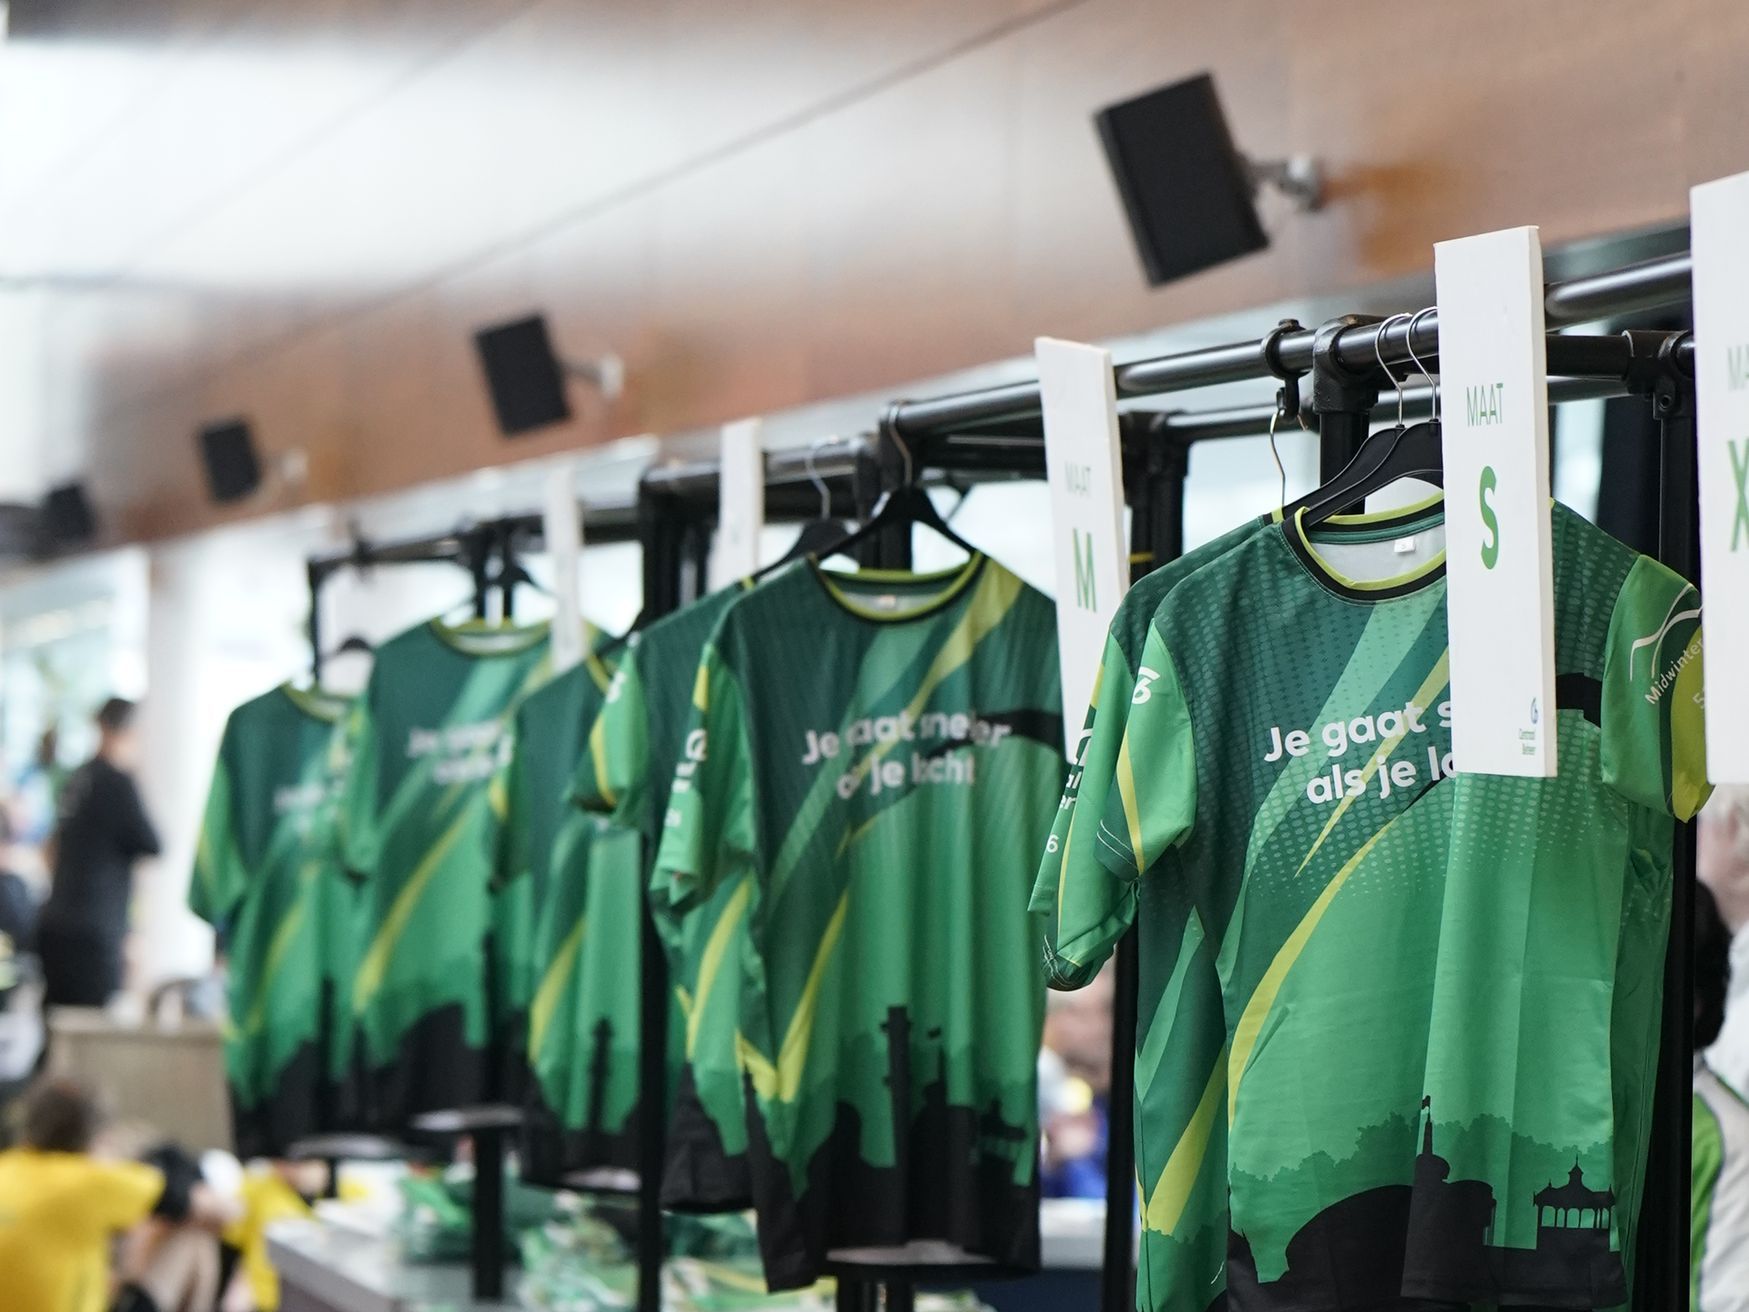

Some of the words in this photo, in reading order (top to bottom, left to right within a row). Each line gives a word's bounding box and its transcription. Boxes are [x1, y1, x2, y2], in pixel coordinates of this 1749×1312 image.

[1466, 382, 1504, 428] MAAT
[1479, 465, 1500, 570] S
[1072, 527, 1097, 613] M
[802, 729, 841, 765] Je
[845, 708, 916, 747] aat
[1263, 726, 1311, 762] Je
[1321, 701, 1427, 758] gaat
[1306, 763, 1367, 804] als
[1375, 754, 1417, 800] je
